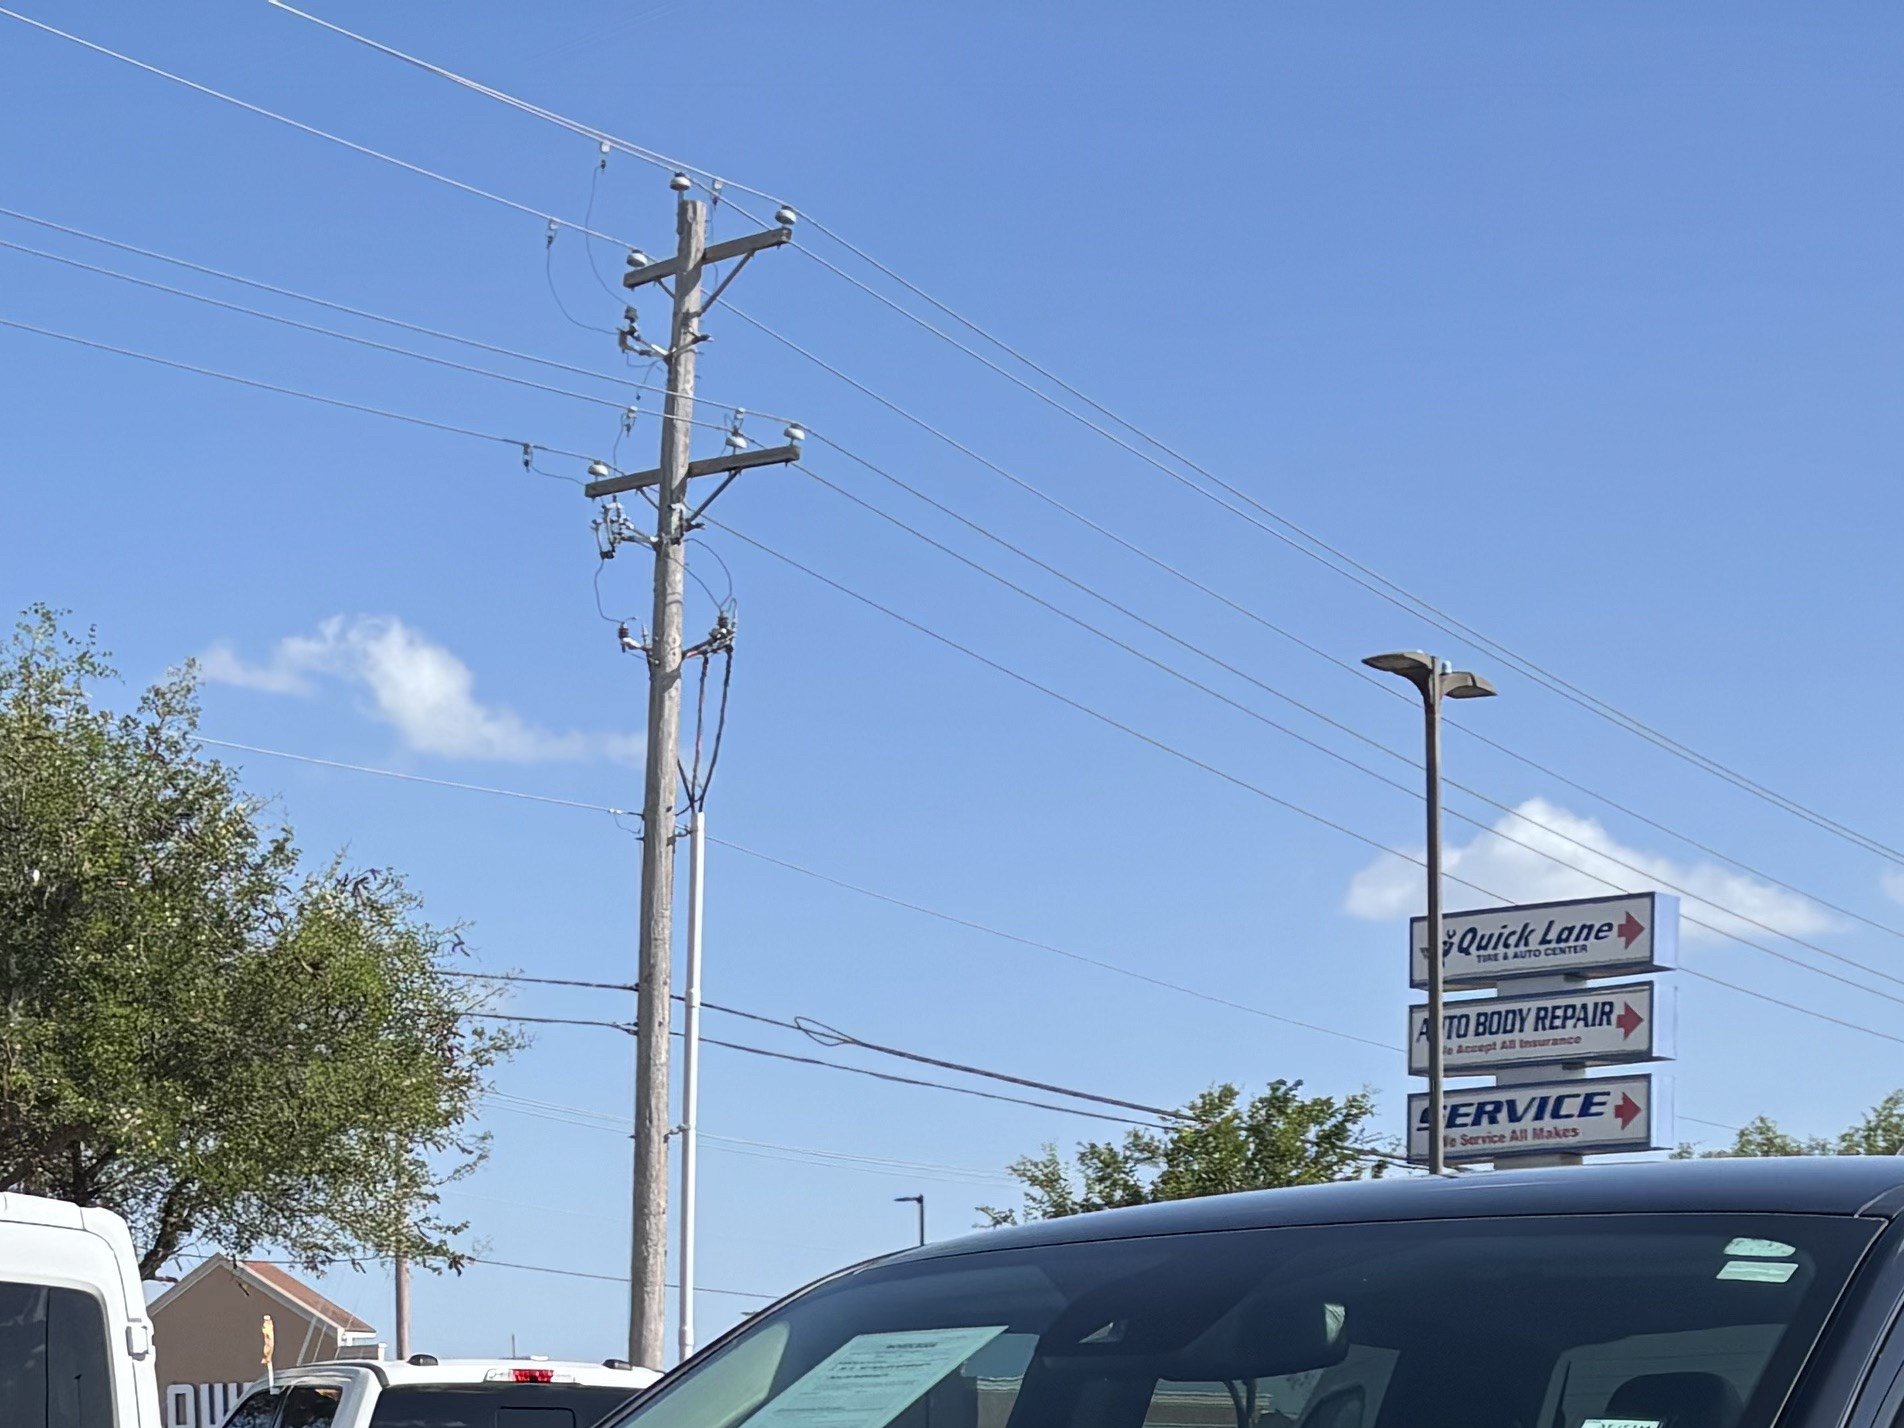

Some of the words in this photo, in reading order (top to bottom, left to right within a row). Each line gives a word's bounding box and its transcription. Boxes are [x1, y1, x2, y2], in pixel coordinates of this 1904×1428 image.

[1457, 922, 1536, 956] Quick
[1538, 920, 1613, 946] Lane
[1476, 954, 1499, 963] TIRE
[1512, 949, 1541, 960] AUTO
[1544, 944, 1588, 957] CENTER
[1415, 1014, 1470, 1043] ATO
[1474, 1008, 1531, 1037] BODY
[1533, 1001, 1615, 1032] REPAIR
[1457, 1042, 1496, 1055] Accept
[1519, 1036, 1582, 1049] Insurance
[1460, 1131, 1506, 1146] Service
[1509, 1129, 1528, 1142] All
[1532, 1126, 1579, 1140] Makes
